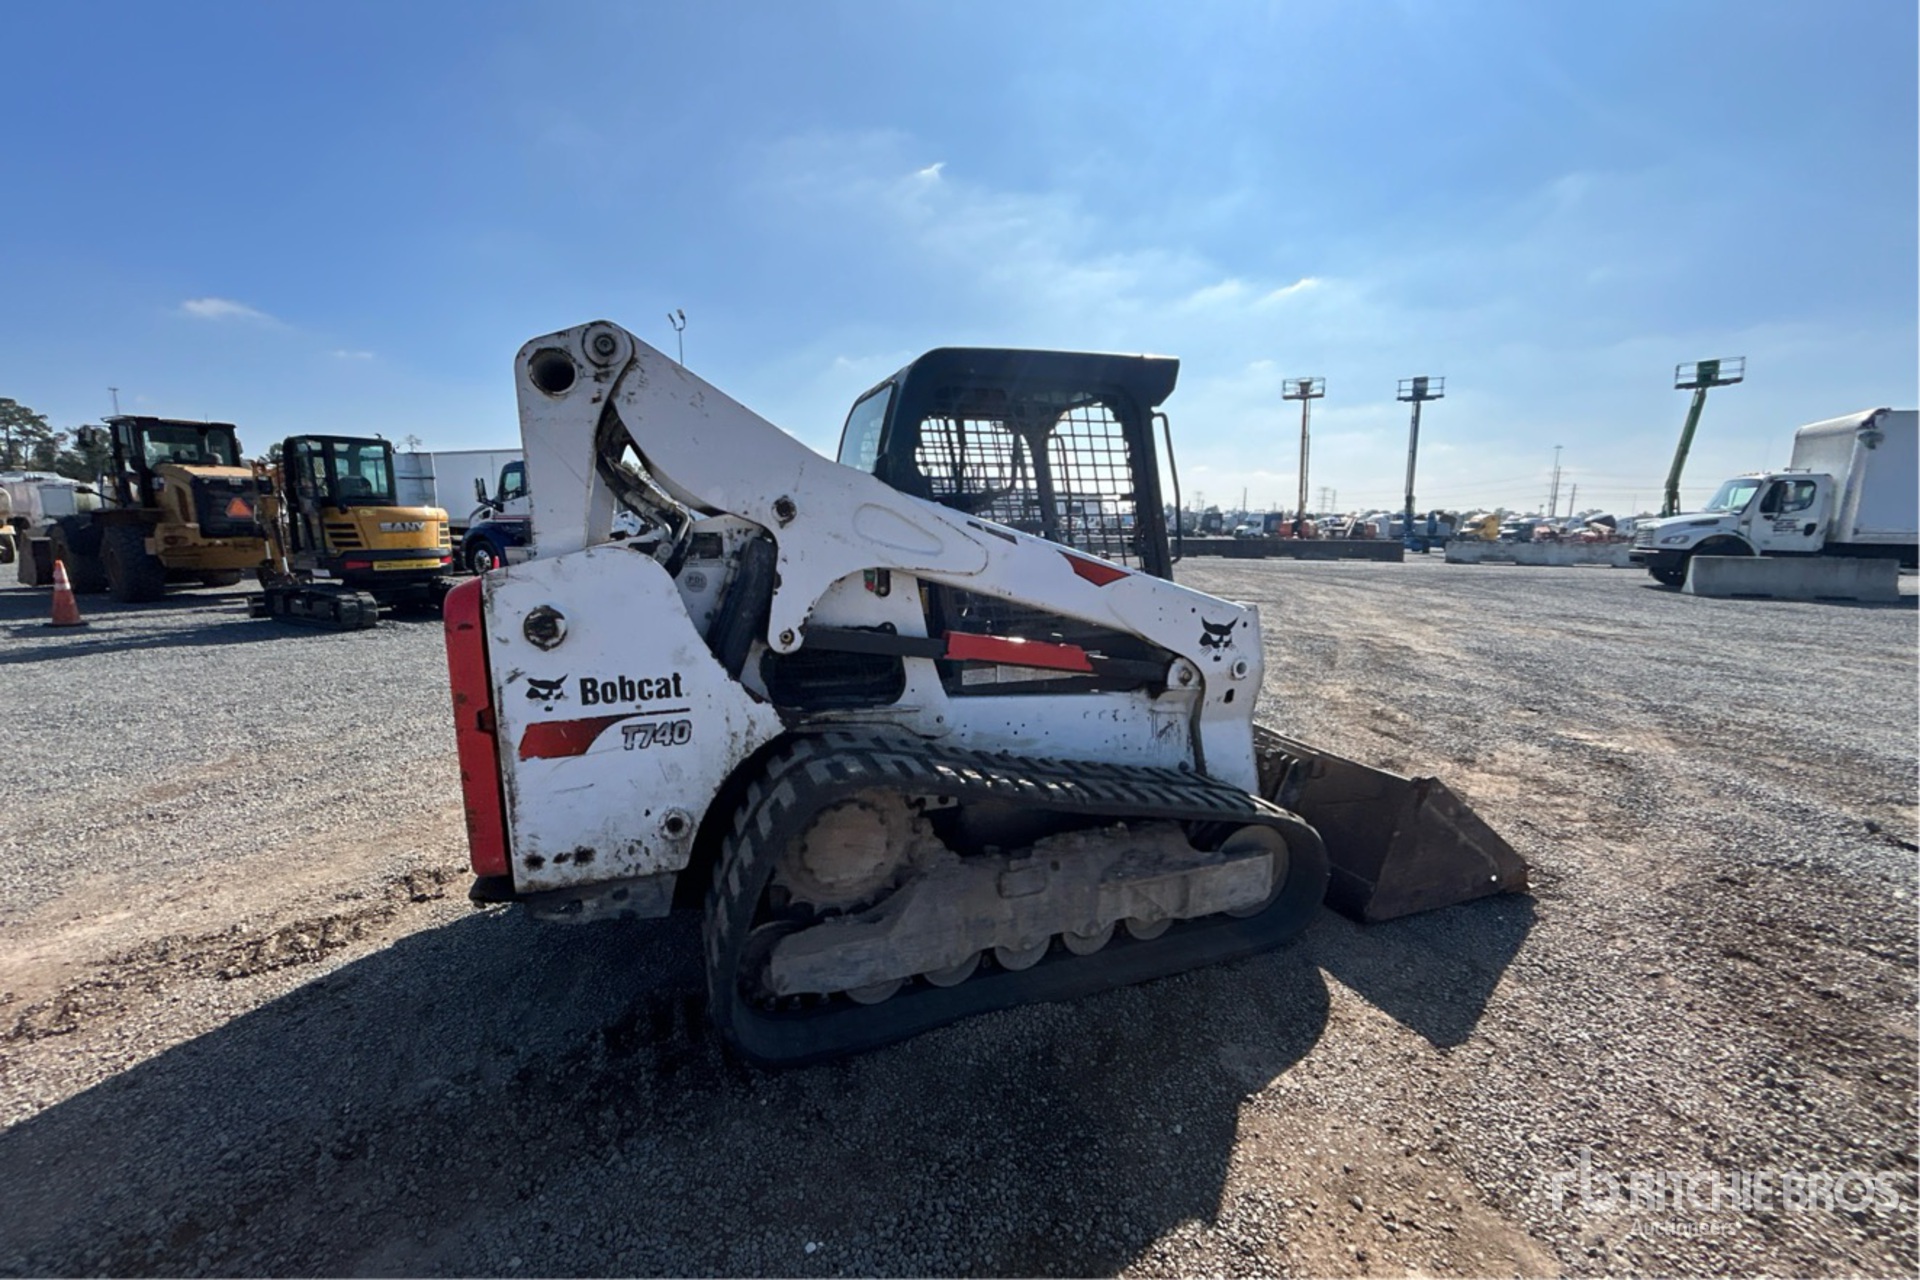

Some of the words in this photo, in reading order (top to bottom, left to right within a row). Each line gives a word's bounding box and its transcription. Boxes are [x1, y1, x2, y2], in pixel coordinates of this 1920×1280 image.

[379, 521, 426, 532] SANY
[579, 672, 683, 705] Bobcat
[621, 719, 692, 751] T740
